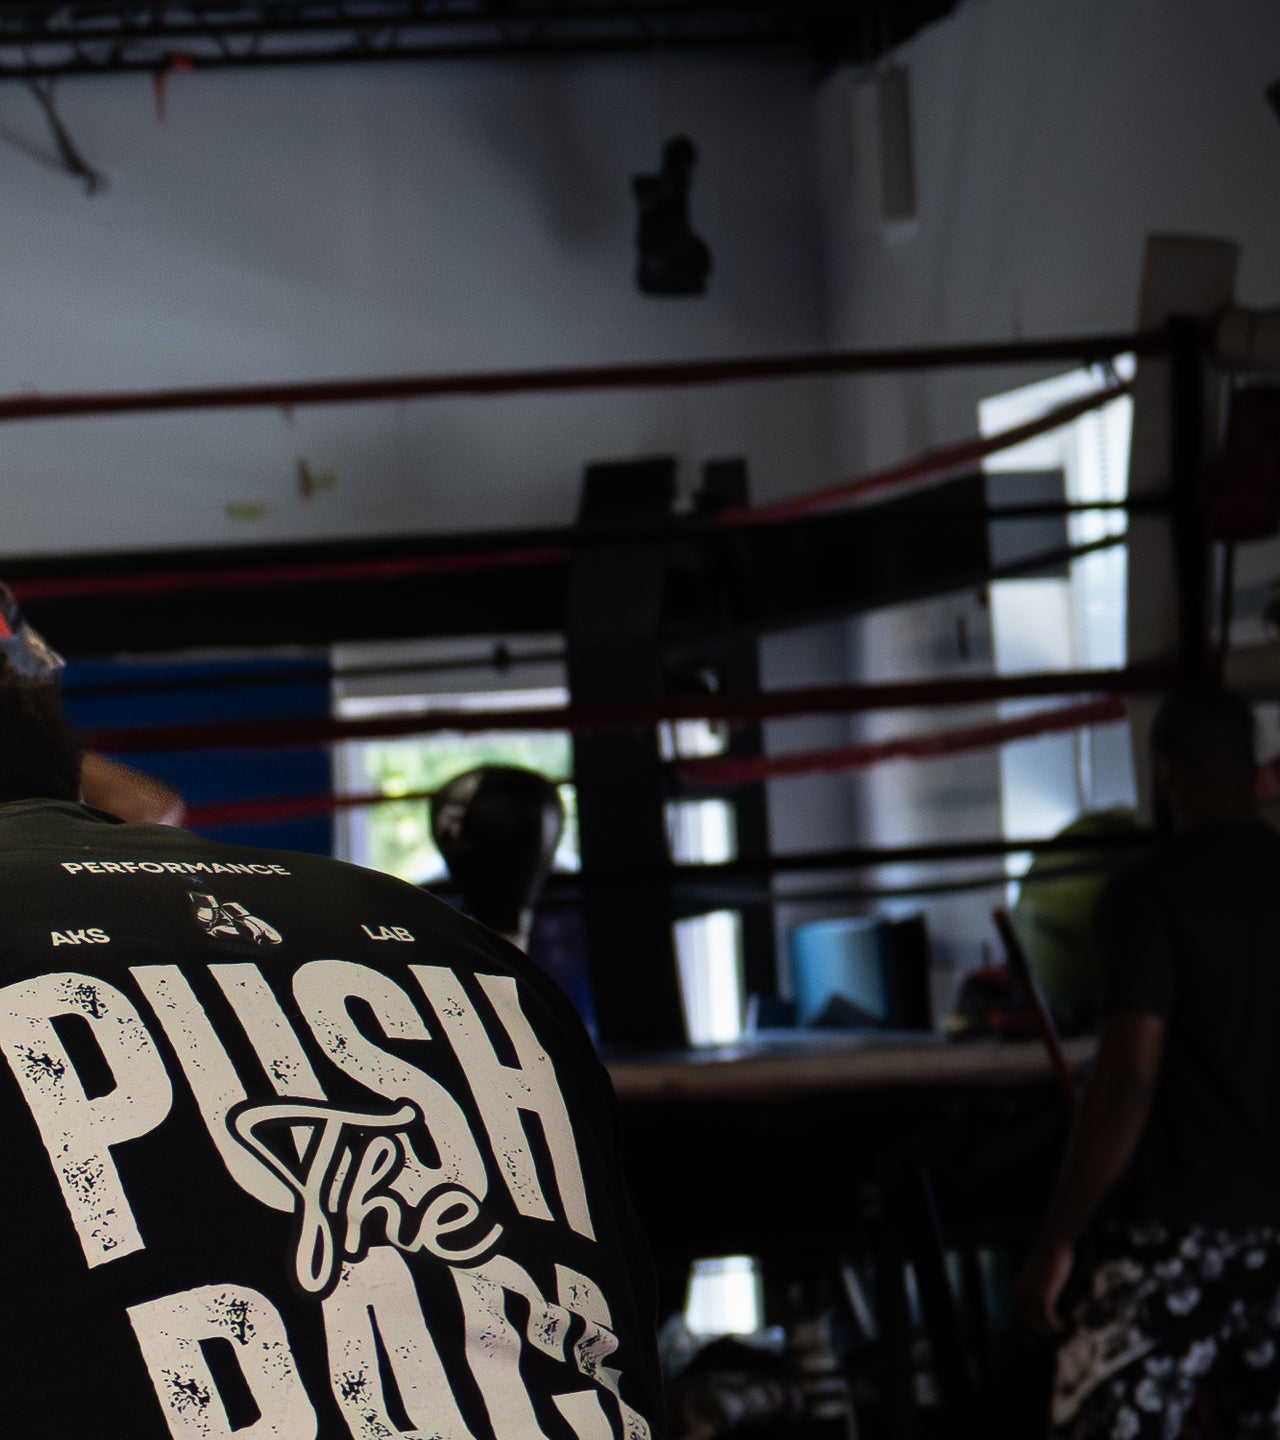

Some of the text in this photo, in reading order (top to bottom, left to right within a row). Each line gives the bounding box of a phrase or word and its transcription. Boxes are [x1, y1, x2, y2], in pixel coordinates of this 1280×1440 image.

[60, 861, 293, 877] PERFORMANCE
[50, 924, 416, 947] AKS LAB
[234, 1100, 505, 1294] The
